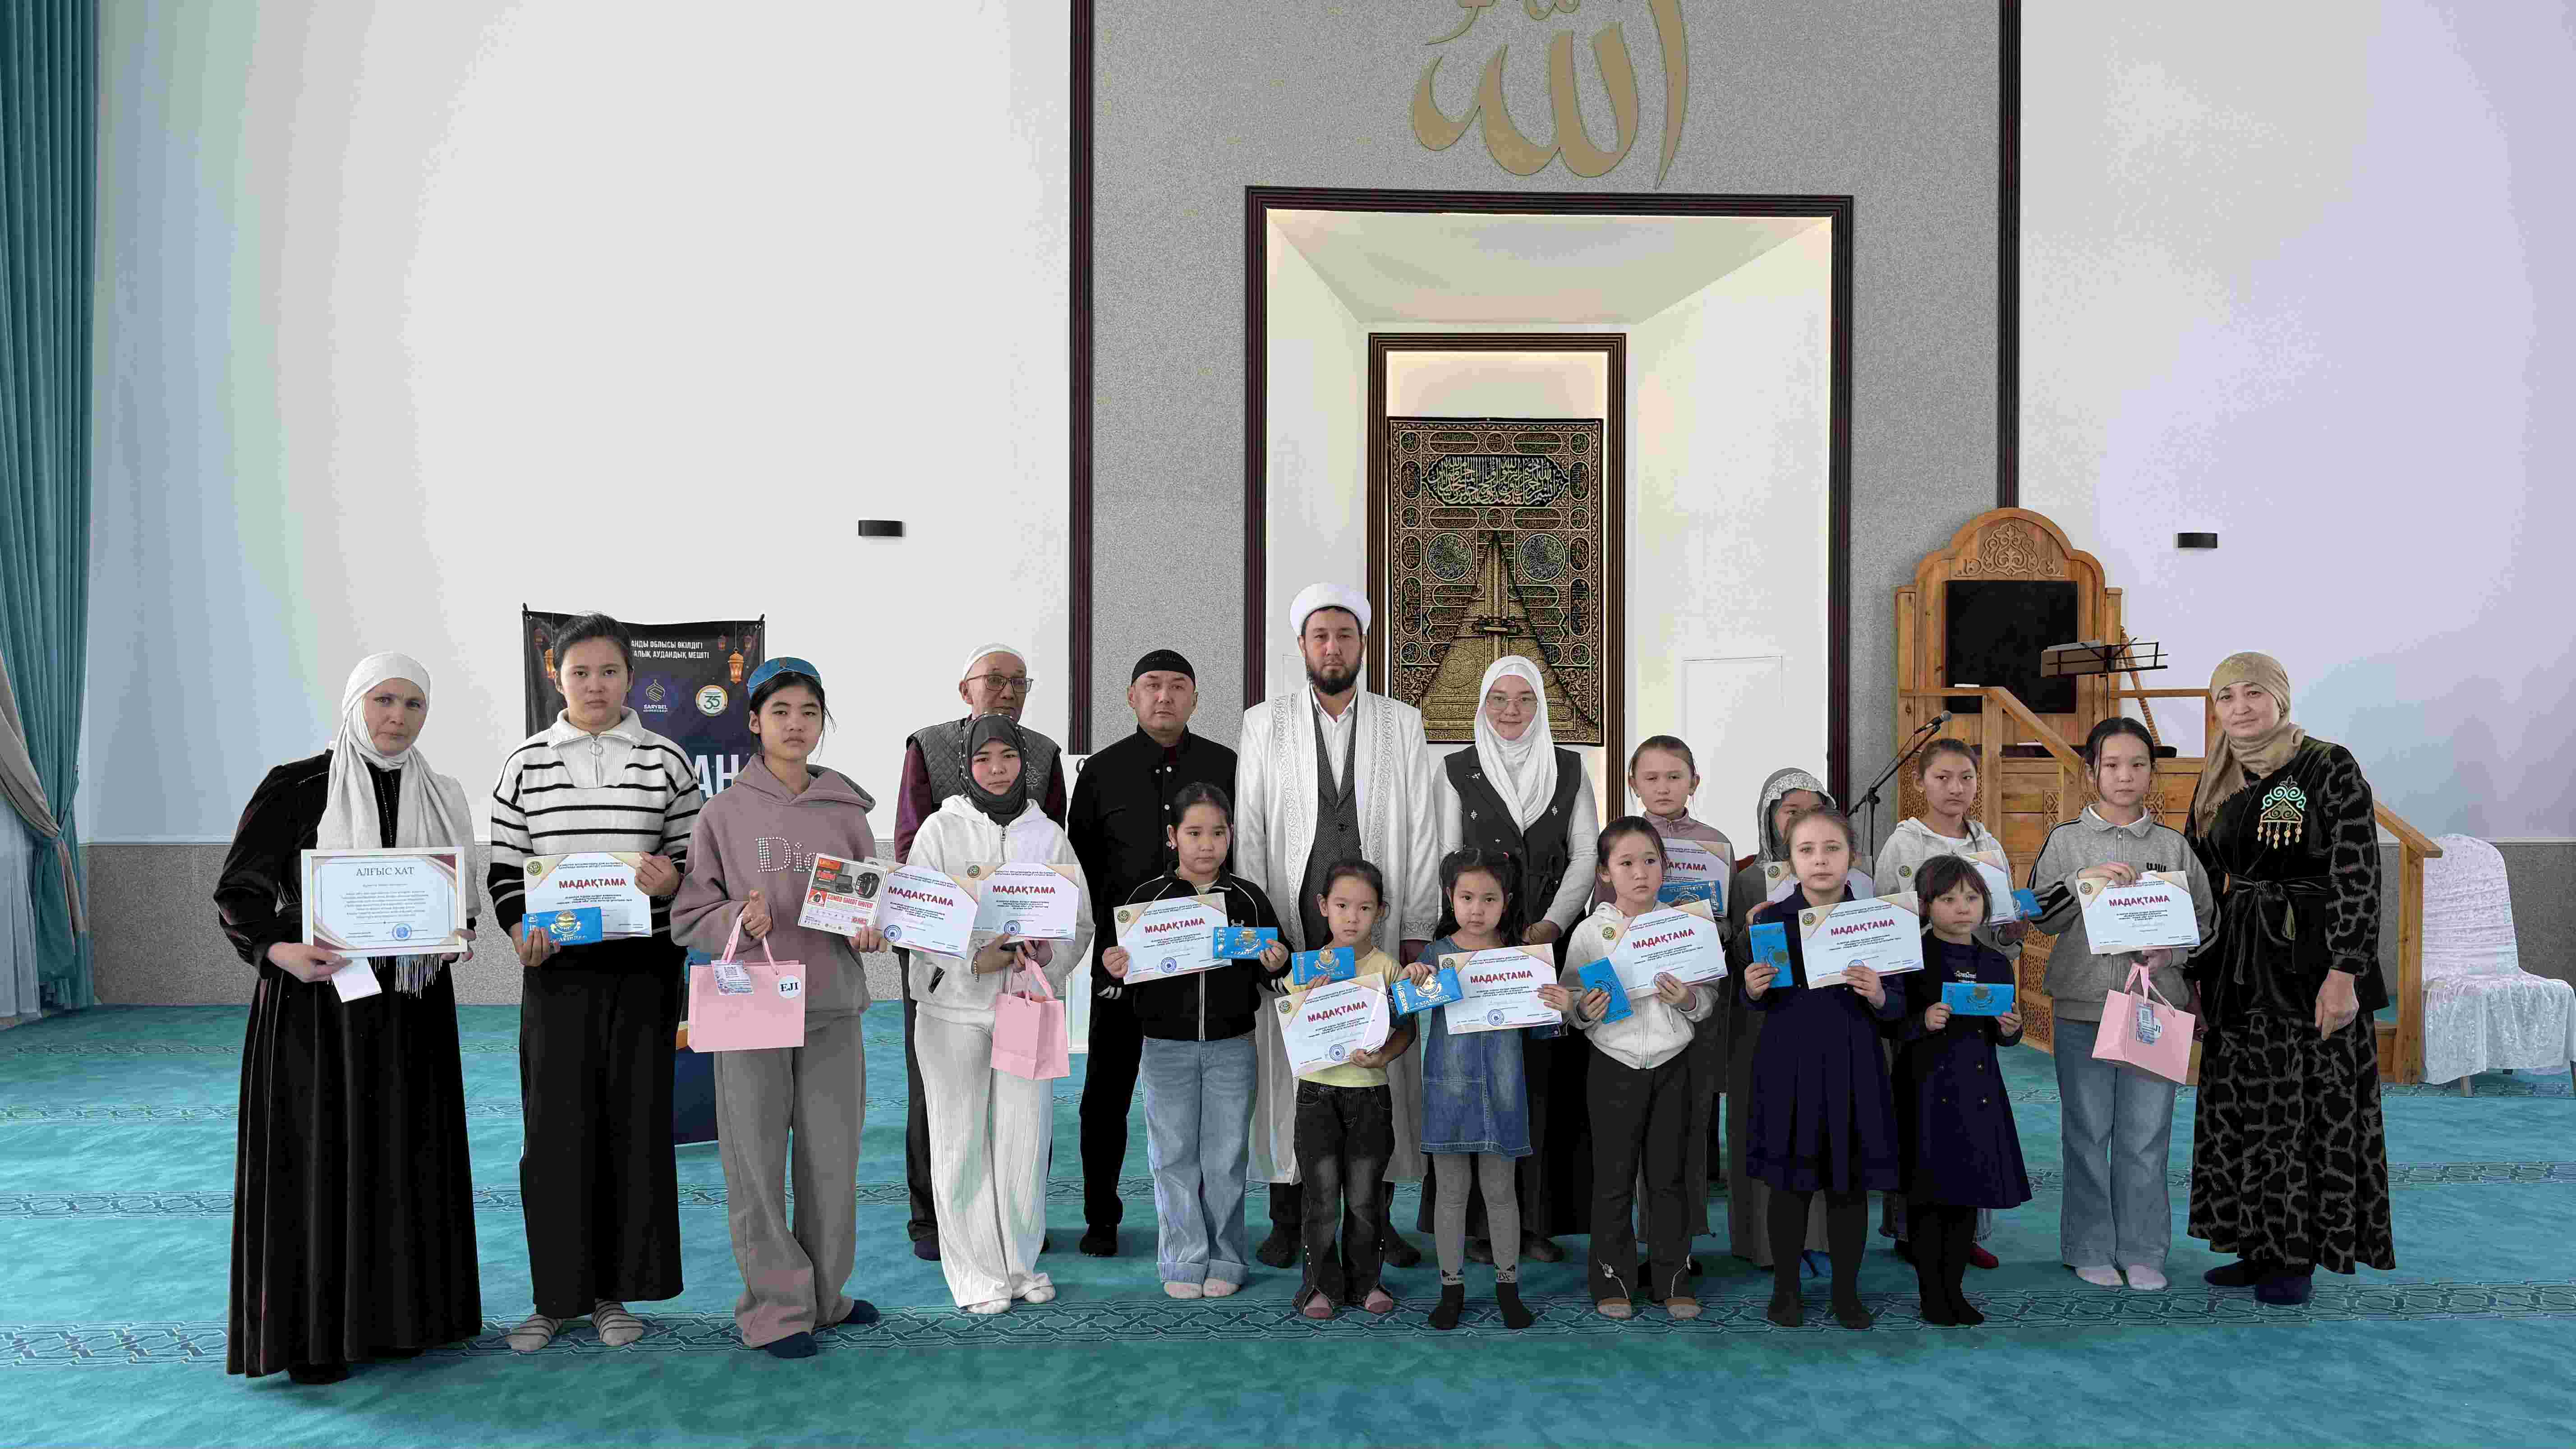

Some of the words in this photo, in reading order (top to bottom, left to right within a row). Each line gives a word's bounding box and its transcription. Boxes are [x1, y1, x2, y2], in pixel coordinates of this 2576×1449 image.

[631, 640, 649, 649] АНДЫ
[633, 650, 651, 659] АЛЫҚ
[653, 651, 687, 659] АУДАНДЫҚ
[695, 754, 739, 801] АН
[394, 866, 415, 875] ХАТ
[1667, 862, 1707, 871] АҚТАМА
[558, 878, 627, 889] МАДАҚТАМА
[992, 885, 1056, 895] МАДАҚТАМА
[888, 886, 954, 907] МАДАҚТАМА
[2109, 895, 2170, 907] МАДАҚТАМА
[1145, 918, 1205, 933] МАДАҚТАМА
[1831, 919, 1895, 936] МАДАҚТАМА
[1632, 928, 1695, 950] МАДАҚТАМА
[1470, 970, 1533, 984] МАДАҚТАМА
[1307, 1001, 1368, 1023] МАДАҚТАМА
